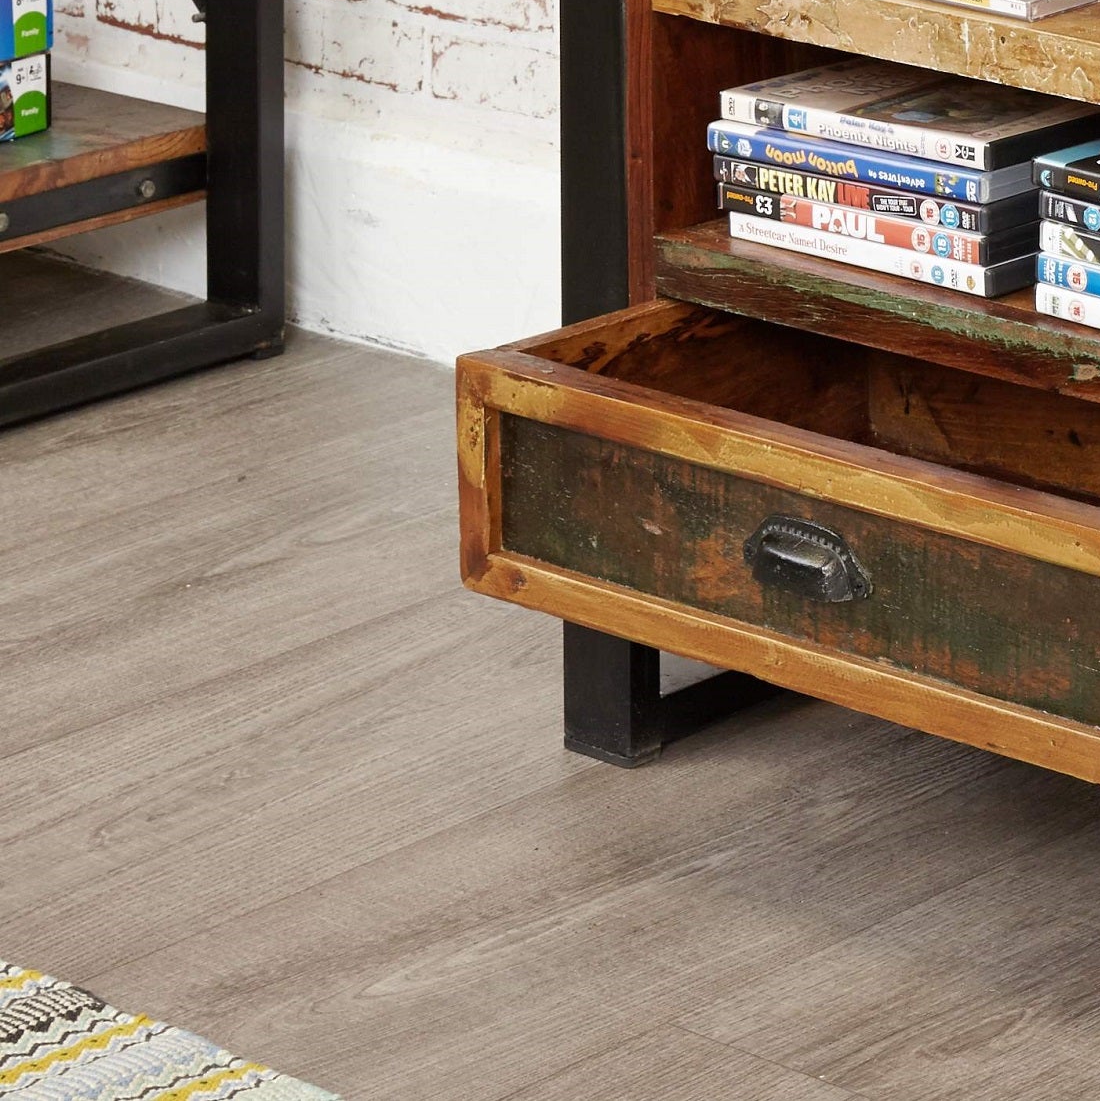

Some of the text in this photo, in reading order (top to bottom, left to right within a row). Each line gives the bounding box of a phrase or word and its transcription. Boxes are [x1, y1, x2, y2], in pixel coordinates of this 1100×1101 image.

[21, 27, 40, 38] Family
[21, 106, 39, 117] Family
[817, 124, 871, 144] Phoenix
[873, 132, 919, 152] Nights
[765, 144, 807, 166] moon
[808, 152, 859, 179] button
[759, 167, 870, 209] PETER KAY LIVE
[868, 169, 925, 189] adventures on
[1067, 175, 1098, 191] Pre-owned
[755, 195, 773, 215] £3
[926, 208, 934, 218] 15
[812, 204, 885, 243] PAUL
[945, 210, 954, 222] 15
[745, 221, 787, 242] Streetcar
[788, 232, 818, 249] Named
[819, 238, 848, 255] Desire
[917, 233, 926, 246] 15
[937, 238, 946, 252] 15
[1072, 272, 1081, 285] 15
